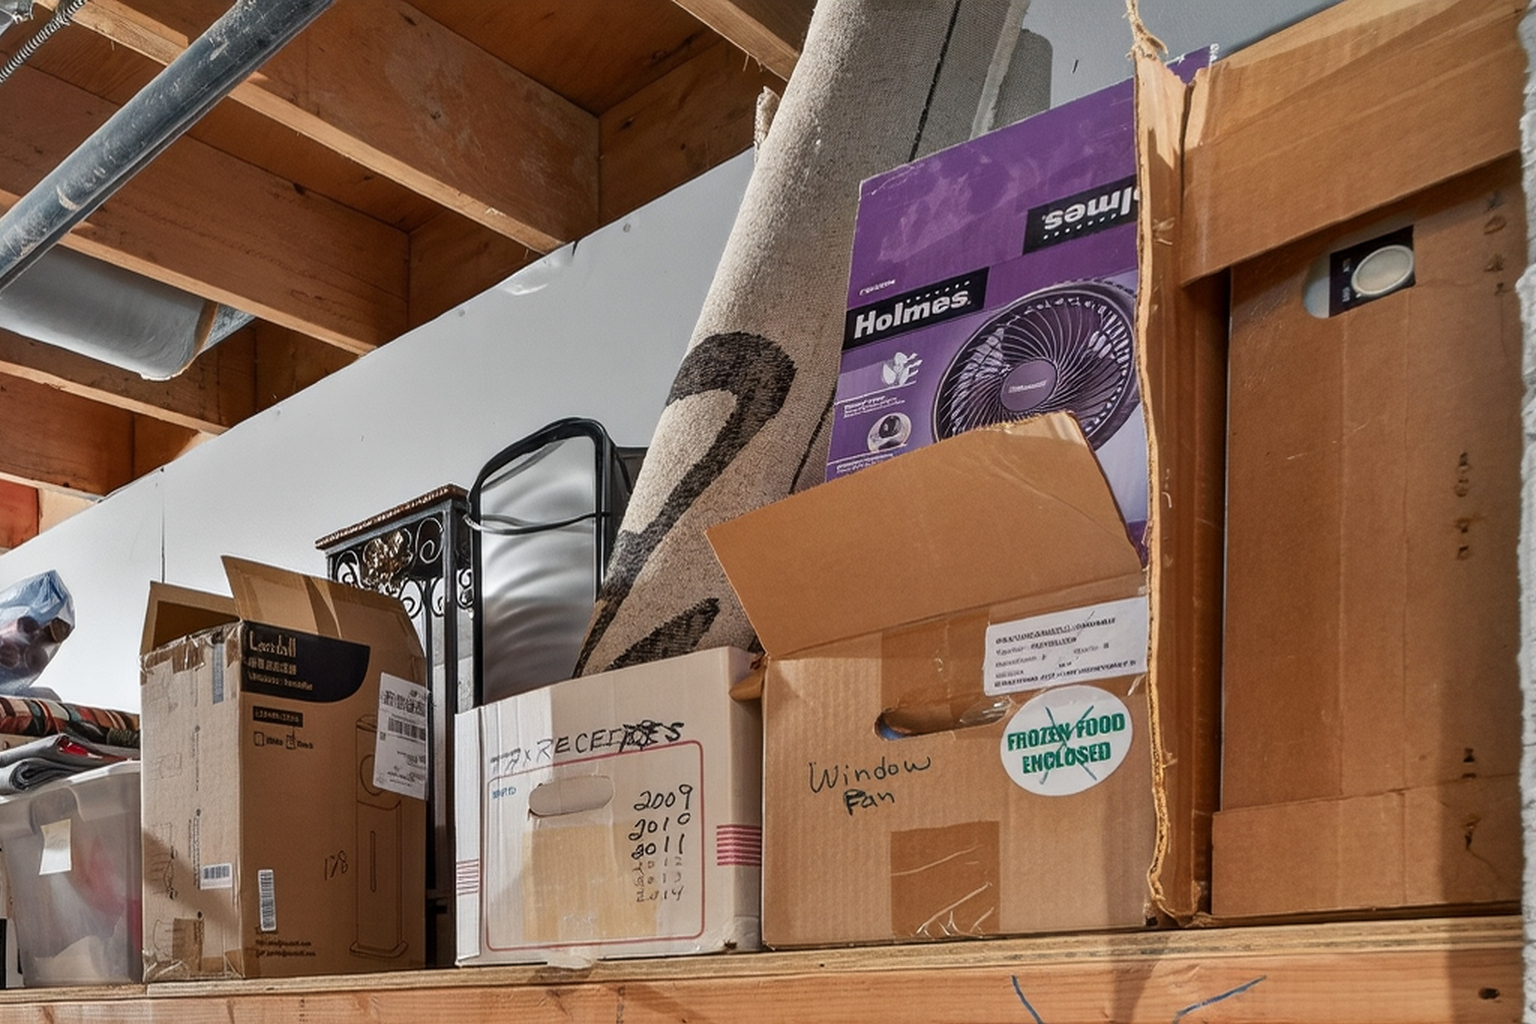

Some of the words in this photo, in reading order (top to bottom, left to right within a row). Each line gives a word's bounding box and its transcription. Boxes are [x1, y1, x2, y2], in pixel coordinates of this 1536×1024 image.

[1043, 185, 1138, 230] lmes
[854, 289, 970, 338] Holmes
[1007, 722, 1072, 751] FROZEN
[1076, 713, 1126, 739] FOOD
[808, 755, 931, 794] Window
[1022, 741, 1112, 774] ENCLOSED
[633, 784, 693, 812] 2009
[628, 812, 691, 841] 2010
[631, 833, 685, 860] 2011
